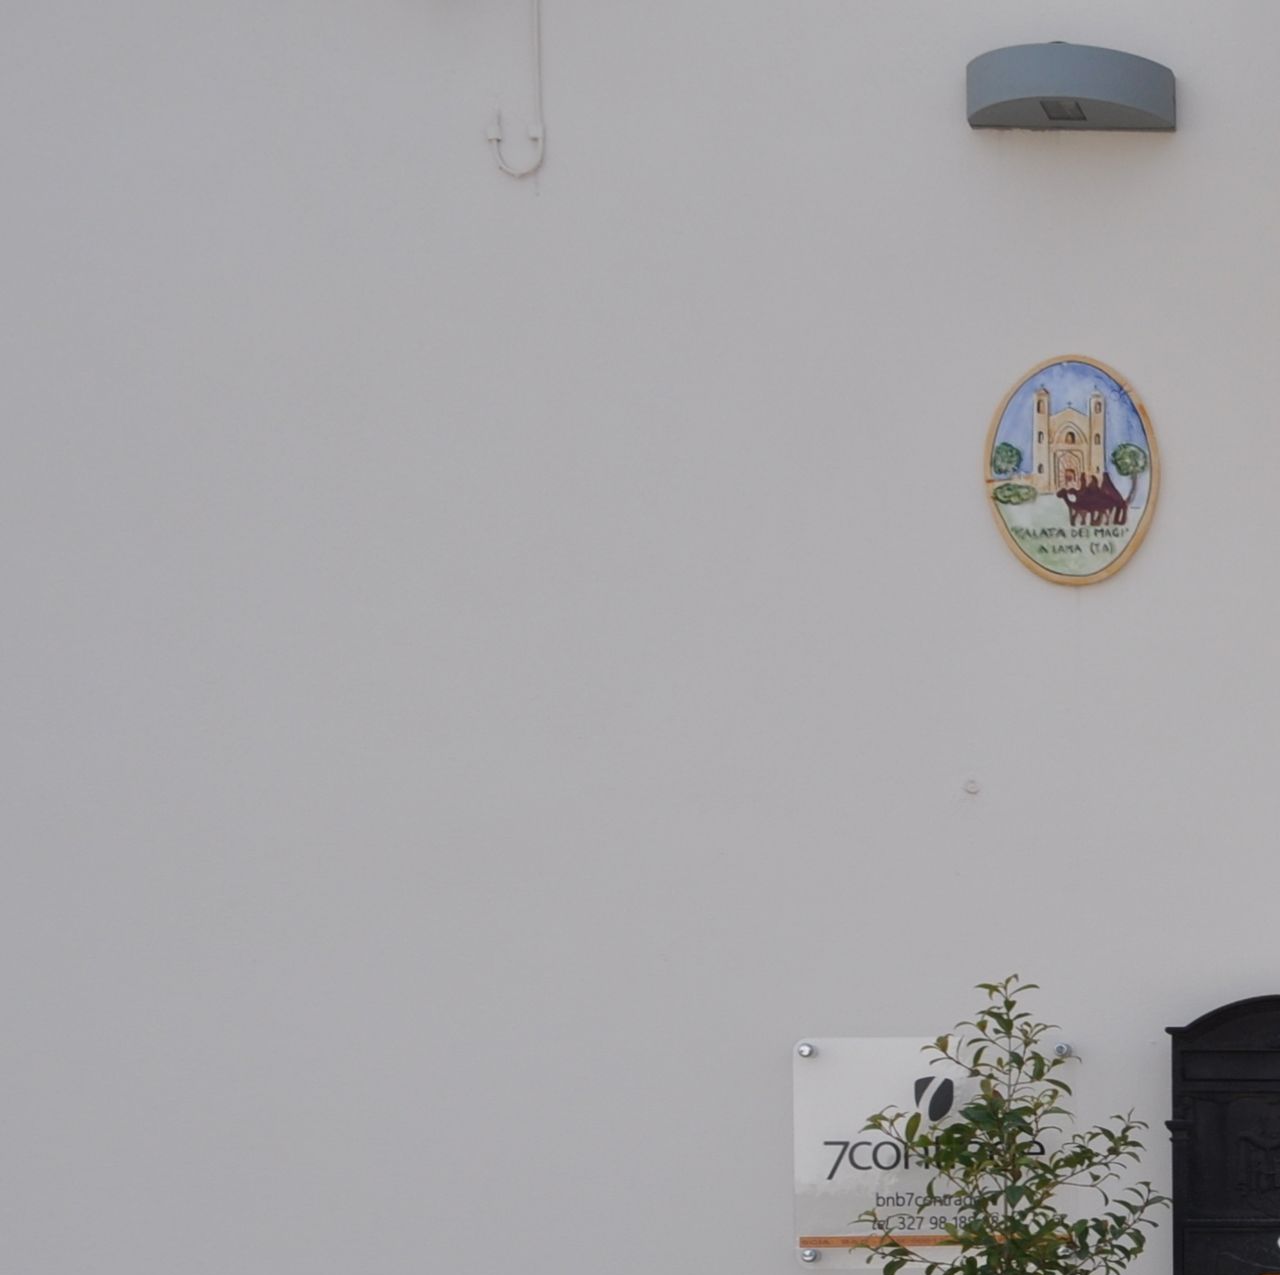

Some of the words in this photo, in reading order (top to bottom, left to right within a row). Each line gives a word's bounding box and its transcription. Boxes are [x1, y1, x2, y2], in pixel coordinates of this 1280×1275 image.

[1070, 527, 1089, 538] DEI
[1038, 544, 1049, 554] A
[897, 1216, 925, 1230] 327
[929, 1216, 947, 1230] 98
